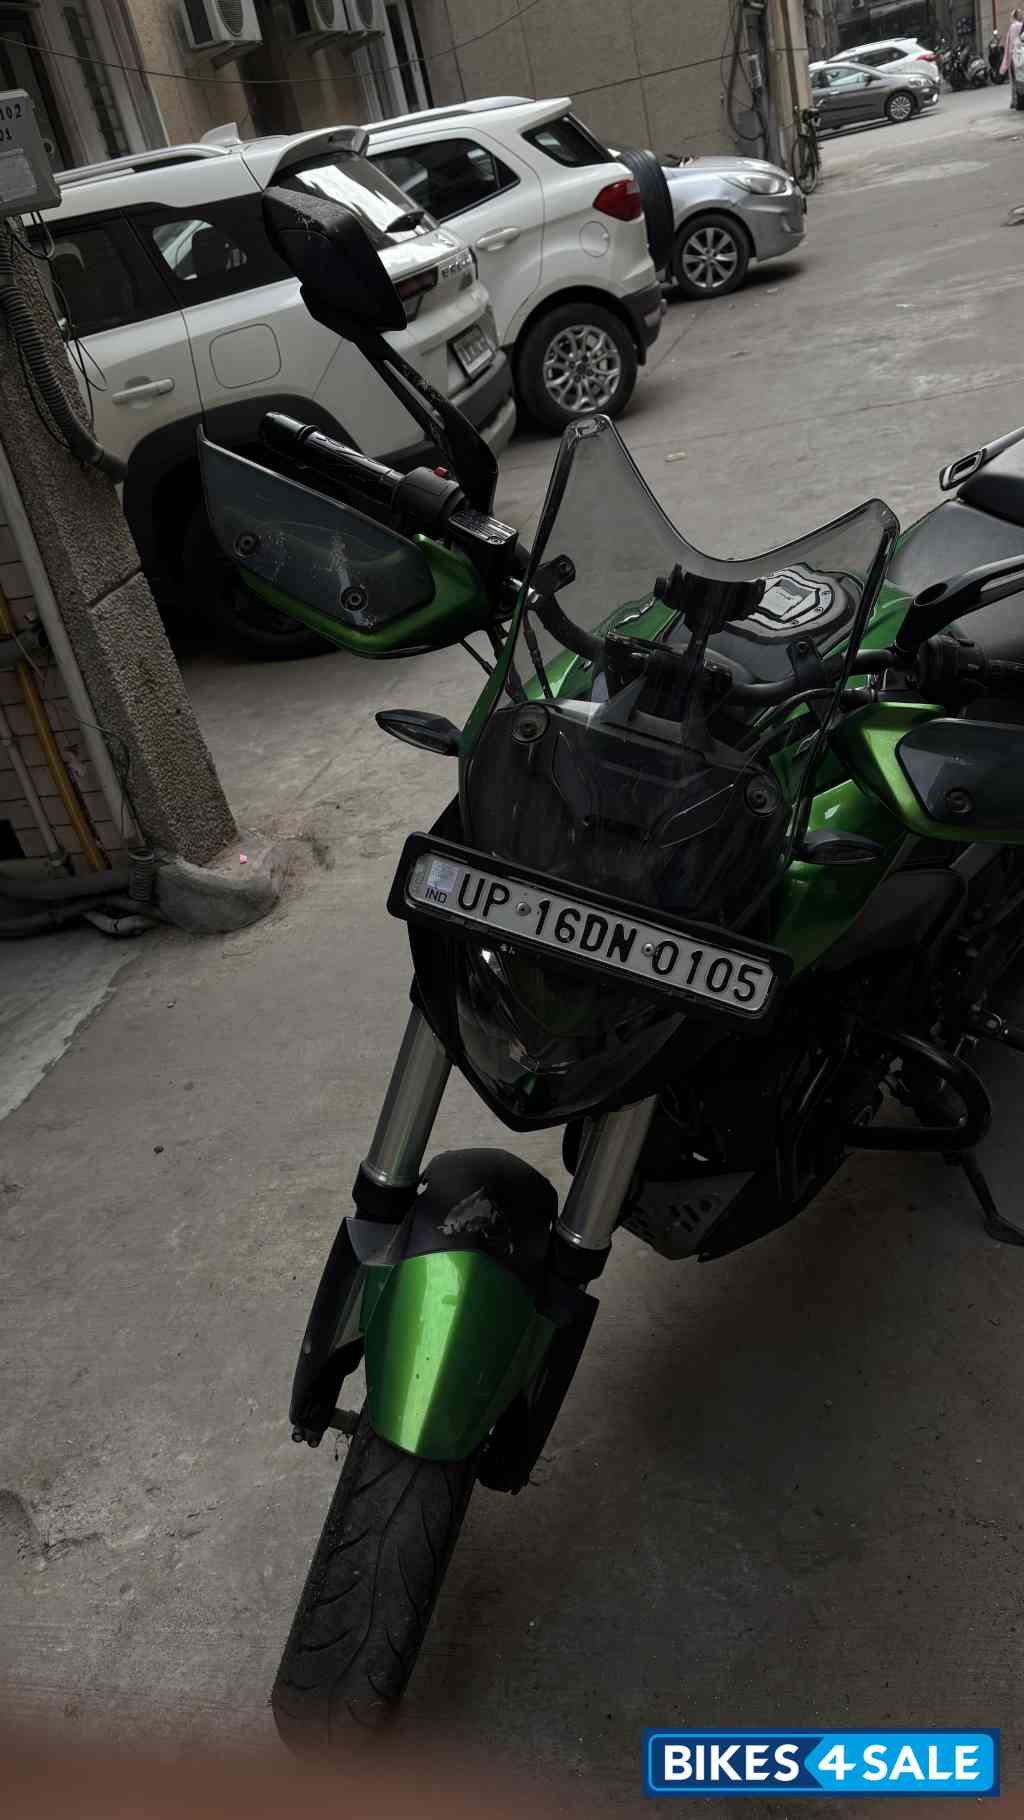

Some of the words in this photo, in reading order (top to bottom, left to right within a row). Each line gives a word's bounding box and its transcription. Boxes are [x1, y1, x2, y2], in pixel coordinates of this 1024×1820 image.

[425, 887, 447, 904] IND
[458, 873, 510, 917] UP
[535, 900, 636, 962] 16DN
[652, 940, 763, 1002] 0105
